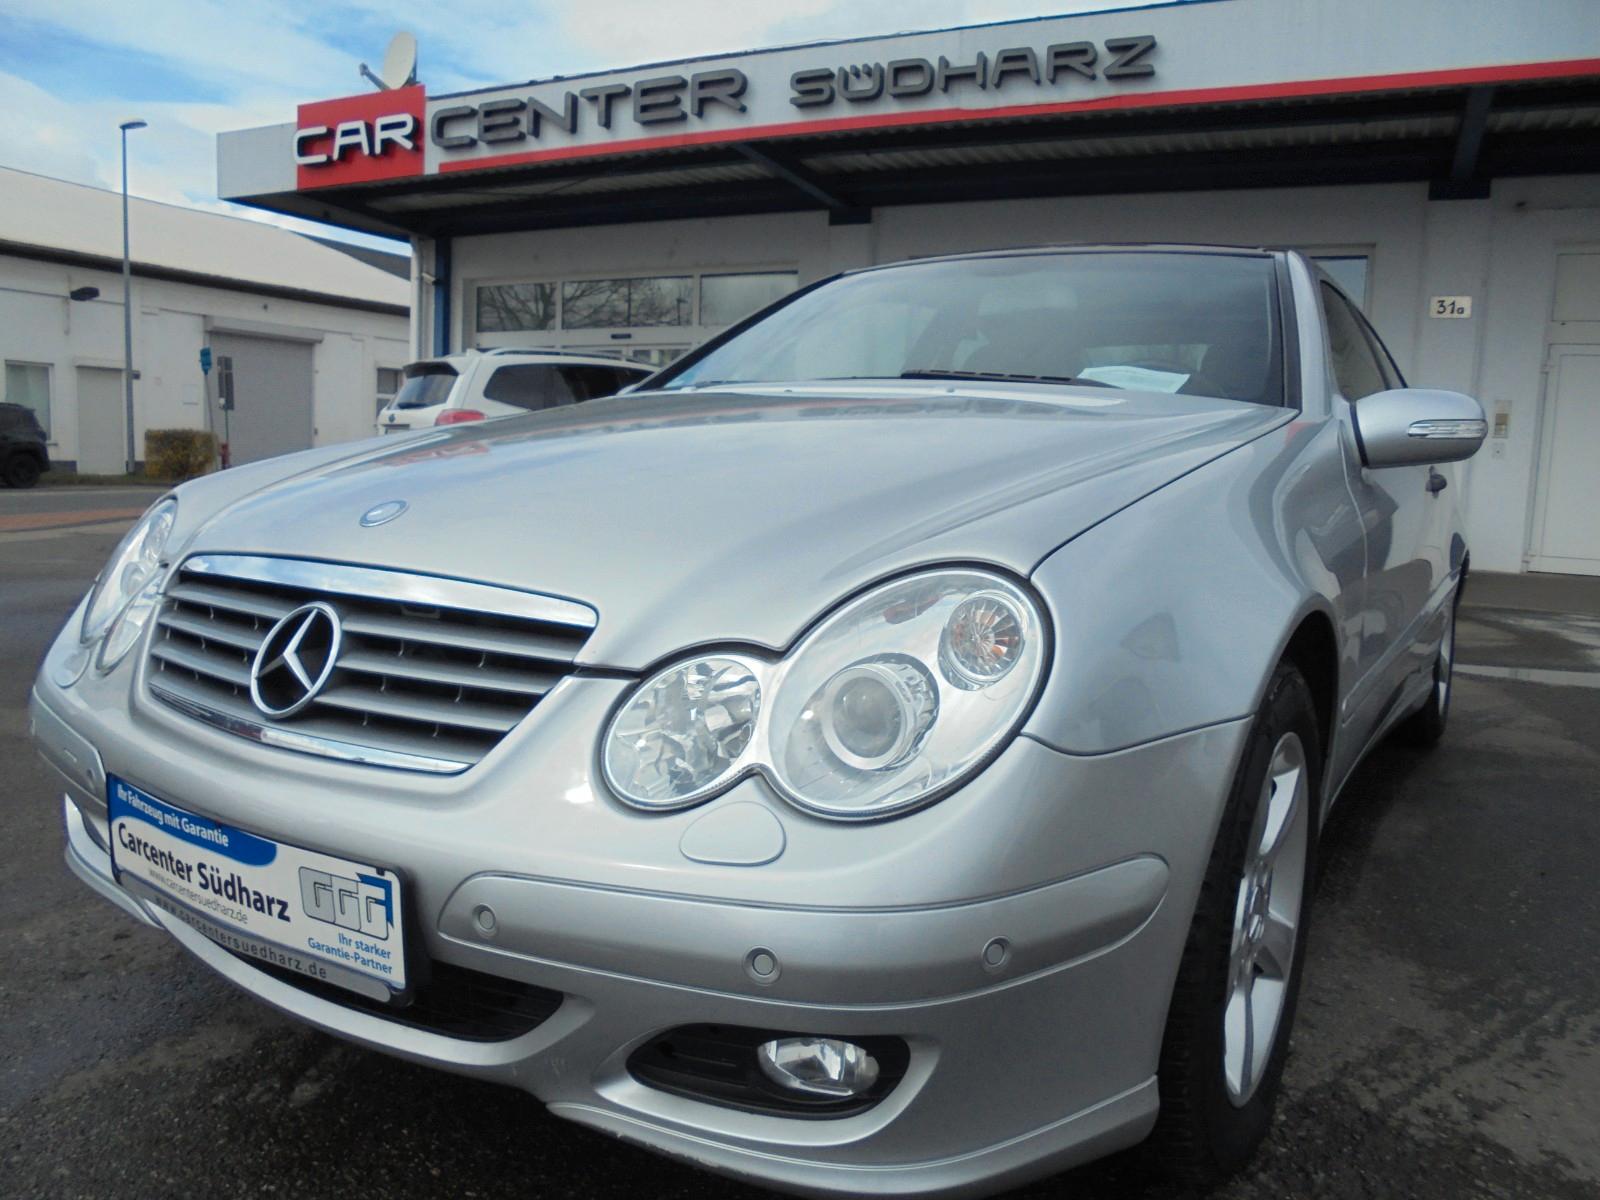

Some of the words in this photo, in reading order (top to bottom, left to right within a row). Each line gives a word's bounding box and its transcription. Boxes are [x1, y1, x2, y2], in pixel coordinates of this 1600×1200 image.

[293, 113, 420, 167] CAR
[430, 68, 748, 150] CENTER
[789, 35, 1157, 109] SÜDHARZ
[1436, 300, 1465, 315] 31a
[117, 783, 128, 802] Ihr
[128, 790, 164, 826] Fahrzeug
[164, 813, 181, 830] mit
[181, 818, 229, 847] Garantie
[118, 822, 193, 883] Carcenter
[197, 862, 291, 923] Südharz
[308, 937, 392, 974] Garantie-Partner
[338, 932, 353, 947] Ihr
[355, 940, 391, 960] starker
